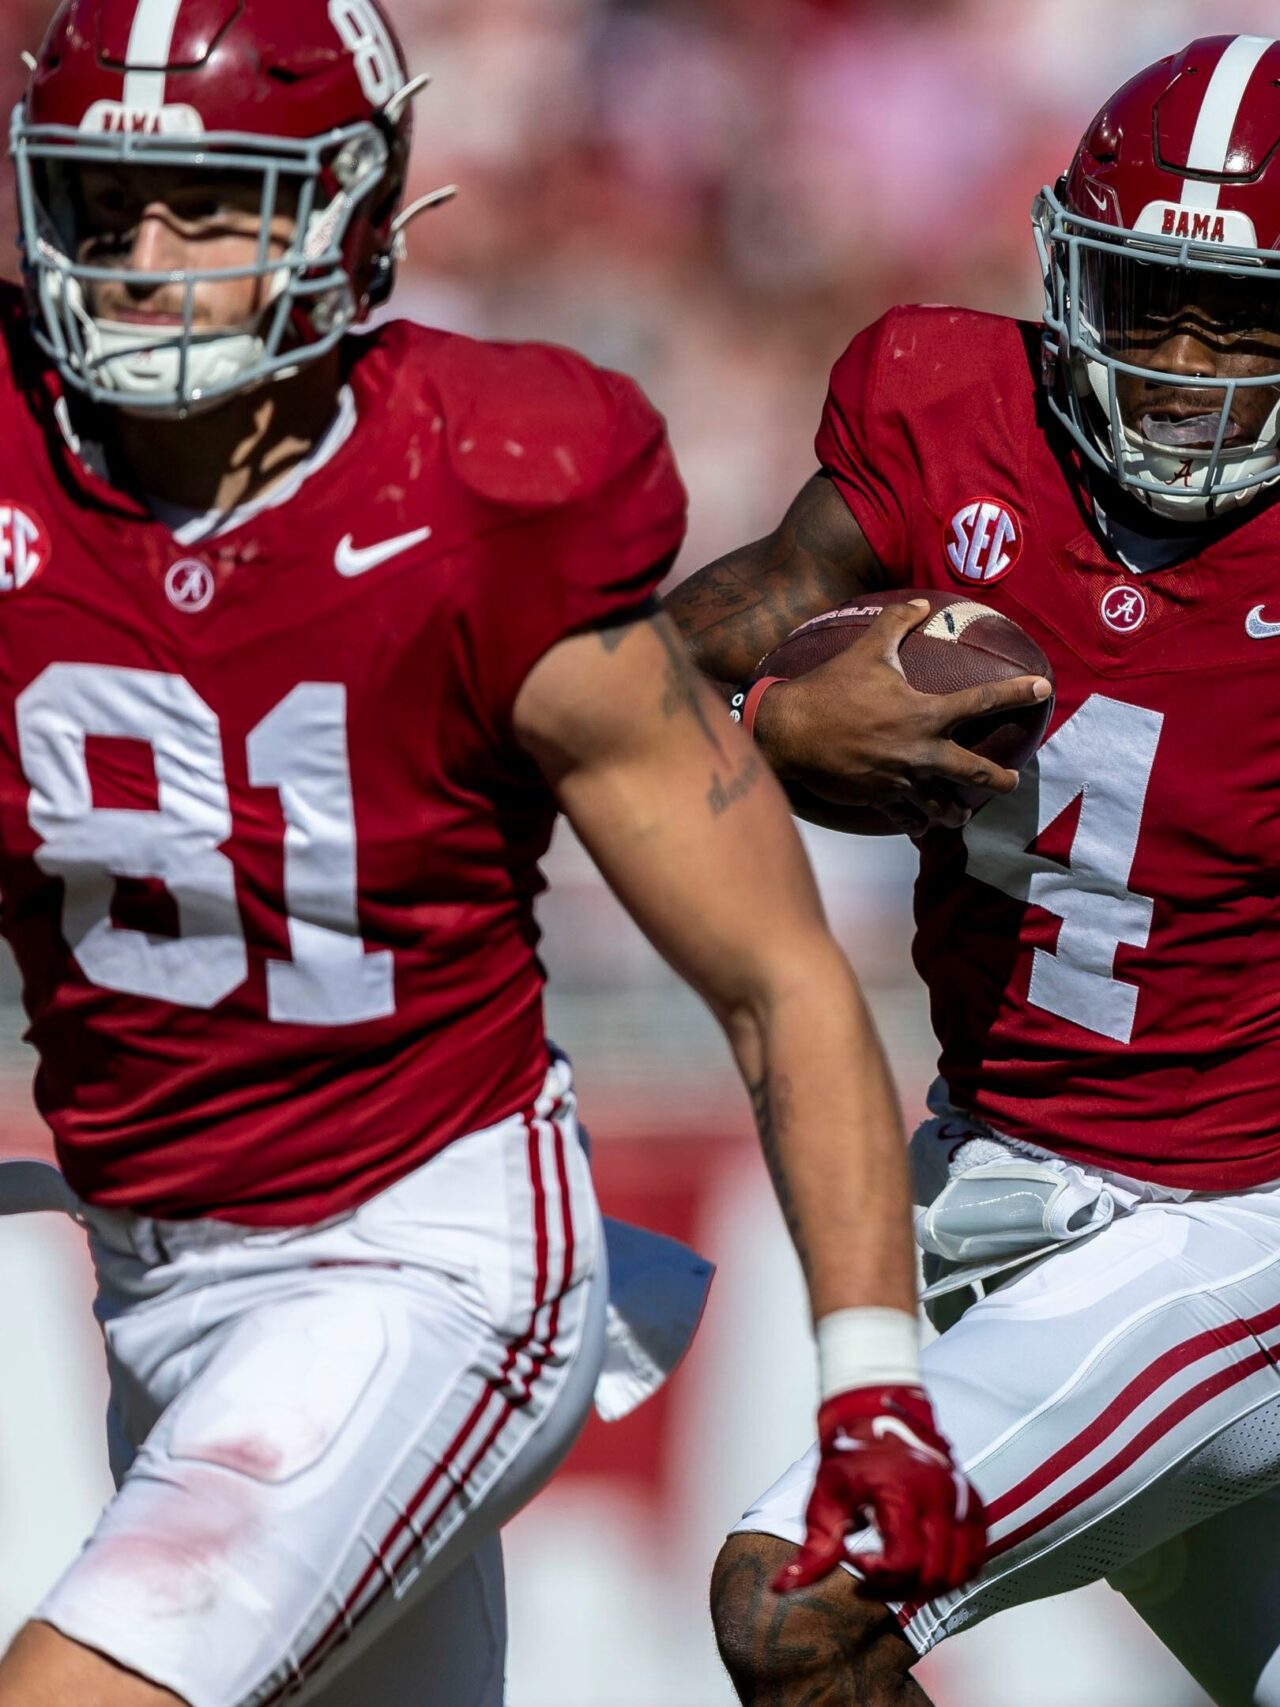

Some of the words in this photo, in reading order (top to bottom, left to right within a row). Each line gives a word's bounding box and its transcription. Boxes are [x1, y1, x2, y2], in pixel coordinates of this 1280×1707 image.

[103, 111, 162, 135] BAMA
[1161, 208, 1225, 242] BAMA
[0, 505, 41, 592] EC
[947, 502, 1016, 580] SEC
[15, 661, 396, 1026] 81
[963, 693, 1164, 1045] 4
